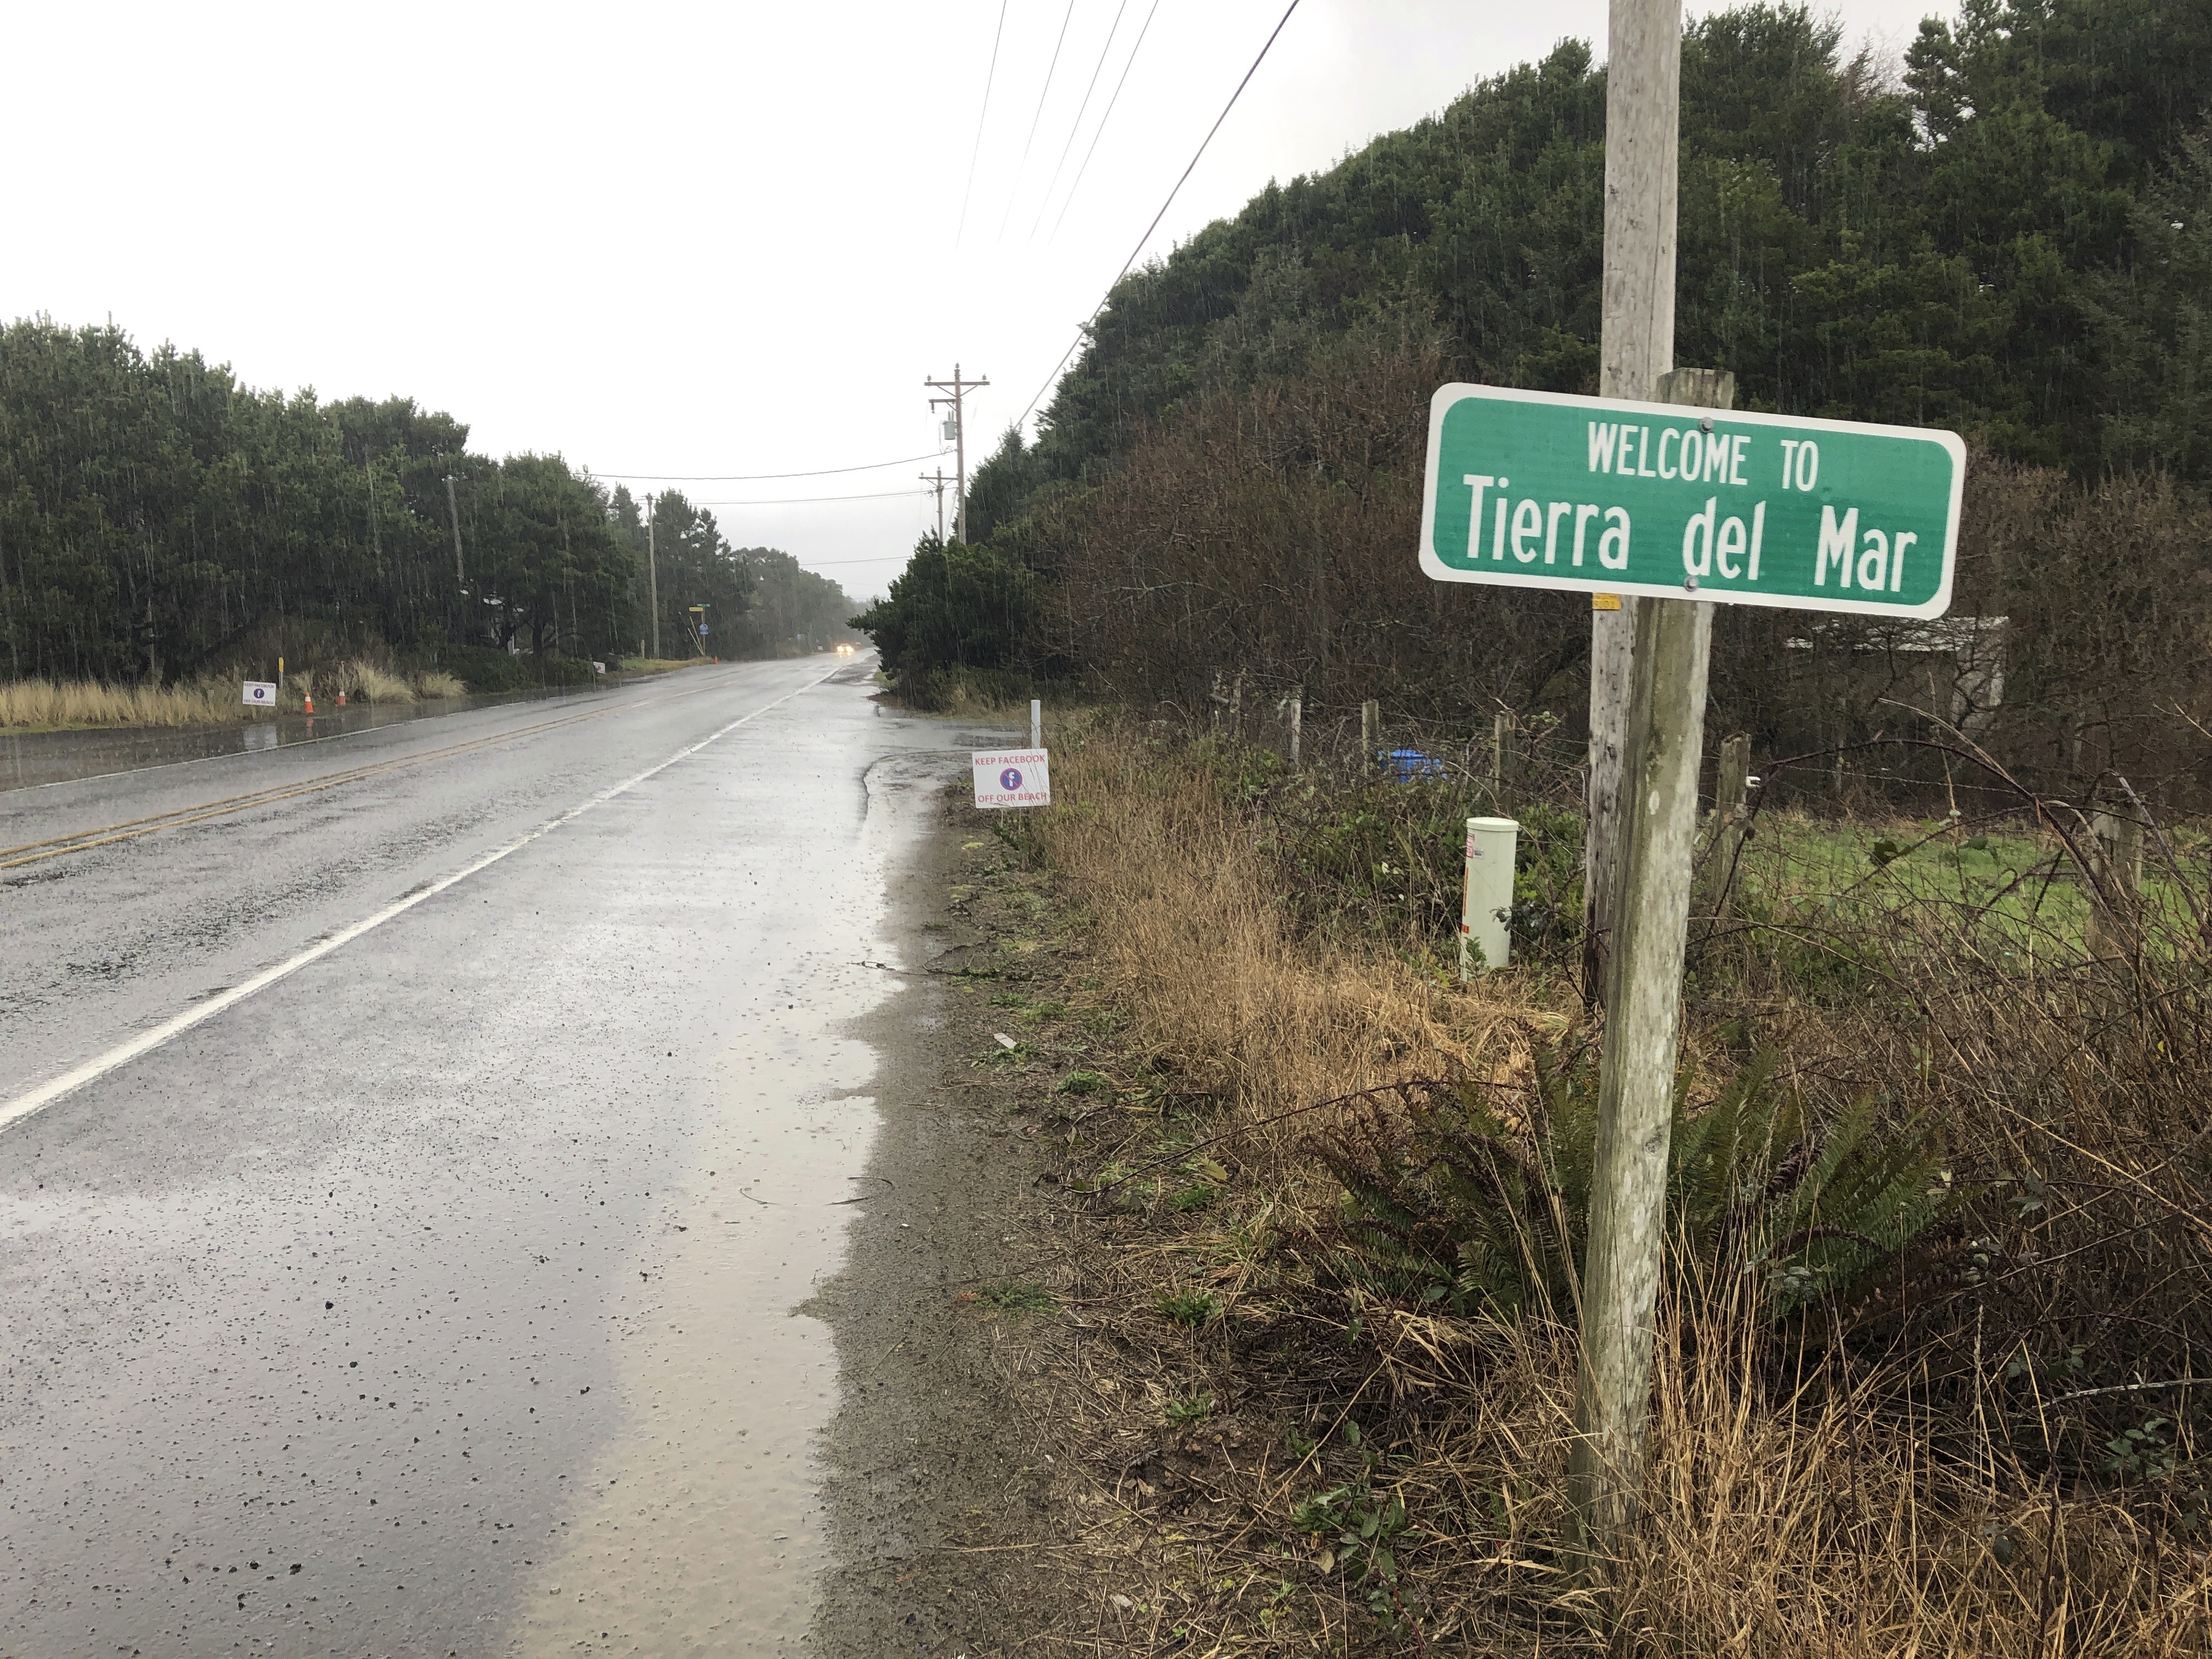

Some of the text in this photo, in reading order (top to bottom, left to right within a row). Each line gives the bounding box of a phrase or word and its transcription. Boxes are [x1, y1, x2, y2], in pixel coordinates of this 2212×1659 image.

[1588, 421, 1819, 492] WELCOME TO
[1463, 474, 1918, 592] Tierra del Mar
[998, 754, 1046, 764] FACEBOOK
[1018, 792, 1047, 801] BEACH
